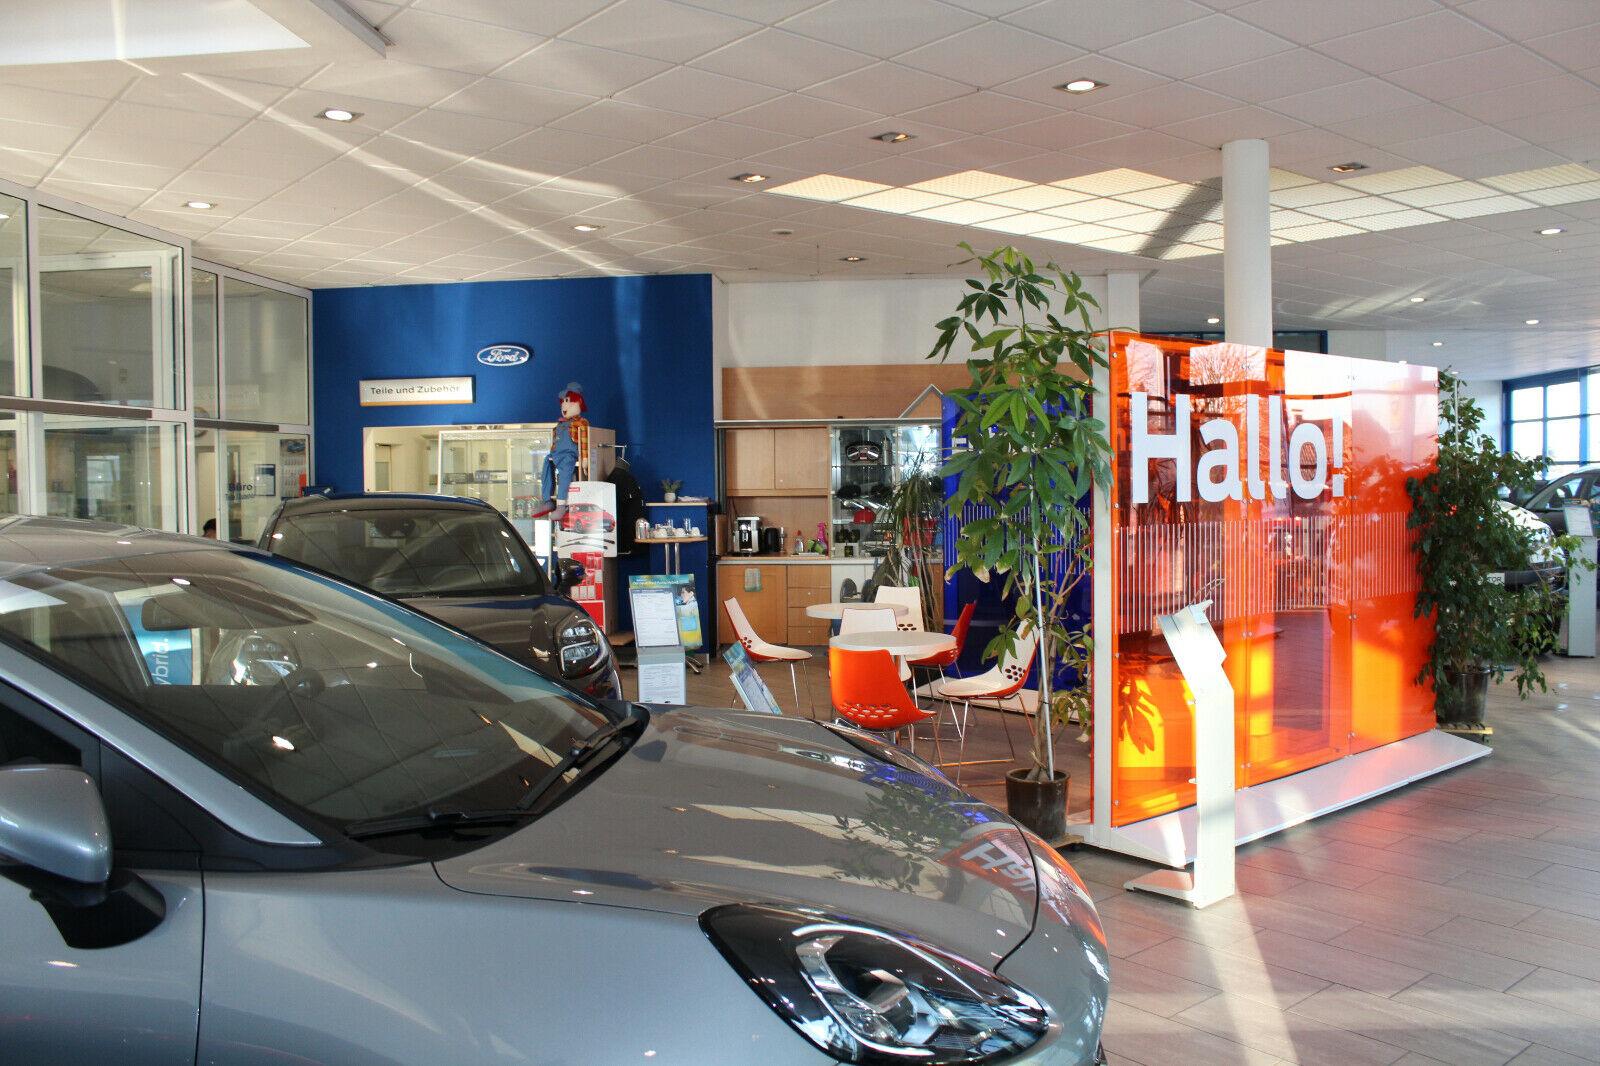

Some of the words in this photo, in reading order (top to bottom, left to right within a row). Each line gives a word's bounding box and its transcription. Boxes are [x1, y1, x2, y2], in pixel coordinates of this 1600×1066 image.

[483, 348, 525, 363] Ford
[371, 386, 394, 395] Teile
[395, 386, 415, 394] und
[417, 385, 460, 394] Zubehör
[1131, 391, 1345, 504] Hallo!
